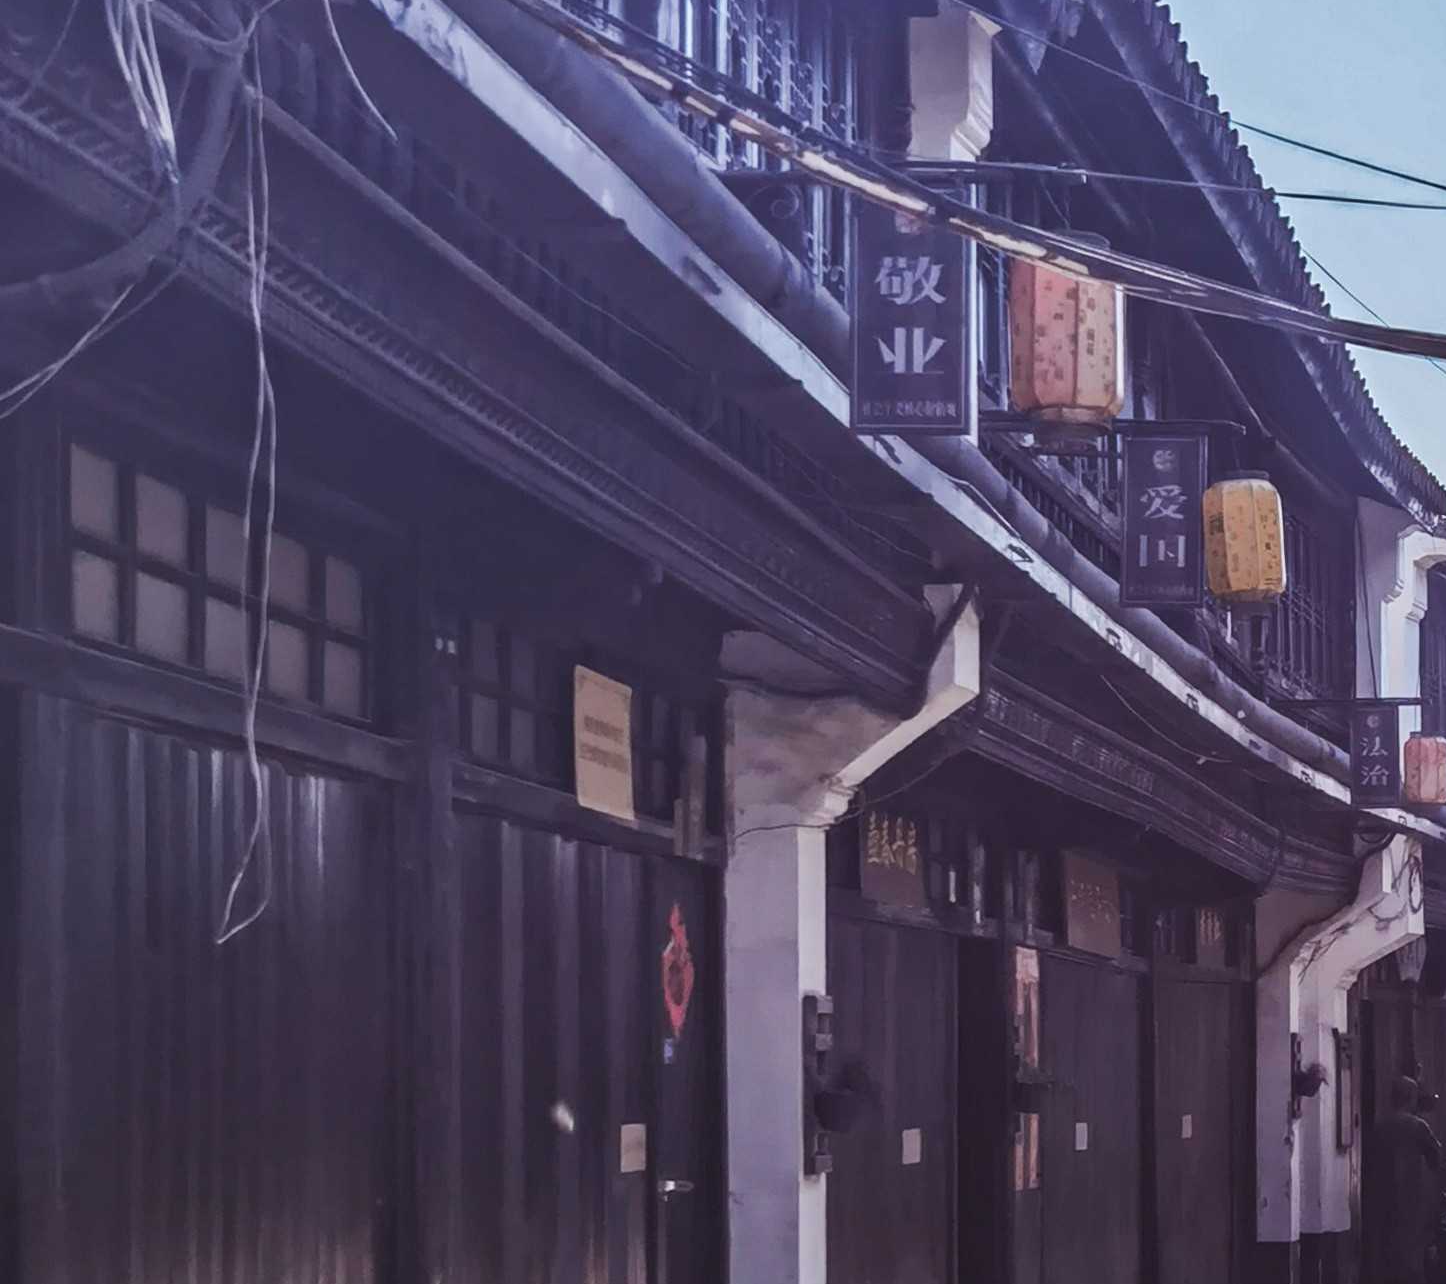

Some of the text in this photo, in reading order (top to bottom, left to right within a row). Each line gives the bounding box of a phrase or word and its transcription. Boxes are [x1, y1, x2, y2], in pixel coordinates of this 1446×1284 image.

[872, 255, 947, 375] 敬业
[1139, 484, 1188, 568] 爱国
[1360, 736, 1389, 787] 法治
